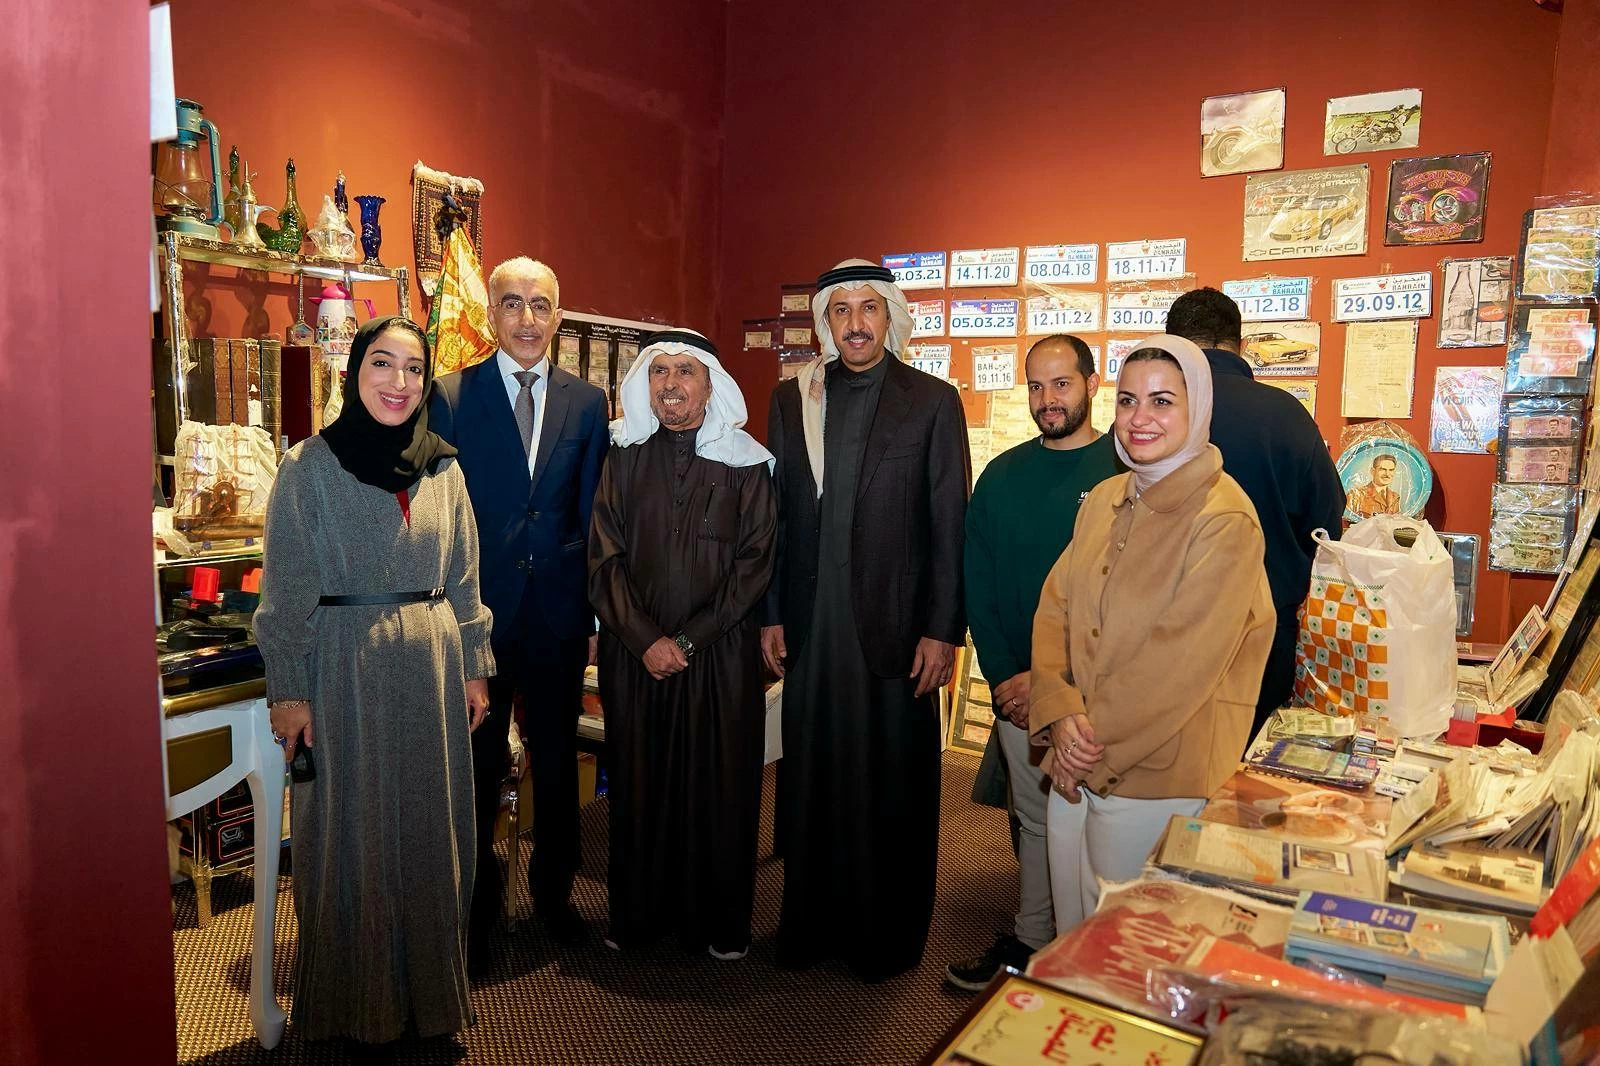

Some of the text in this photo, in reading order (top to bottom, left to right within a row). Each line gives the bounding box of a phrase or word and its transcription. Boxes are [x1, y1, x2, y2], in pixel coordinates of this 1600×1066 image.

[1326, 178, 1362, 187] STRONG!
[1269, 243, 1358, 256] CAMARO
[957, 265, 1010, 280] 14.11.20
[1030, 262, 1091, 277] 08.04.18
[1114, 258, 1177, 275] 18.11.17
[894, 269, 942, 282] 8.03.21
[1392, 276, 1426, 285] البحرين
[1272, 279, 1304, 288] البحرين
[1392, 282, 1426, 291] BAHRAIN
[1272, 286, 1304, 295] BAHRAIN
[1238, 297, 1300, 314] 1.12.18
[1344, 292, 1422, 314] 29.09.12
[951, 317, 1015, 329] 05.03.23
[1033, 310, 1093, 326] 12.11.22
[1113, 310, 1168, 325] 30.10.2
[977, 363, 994, 371] BAH
[977, 372, 1012, 384] 19.11.16
